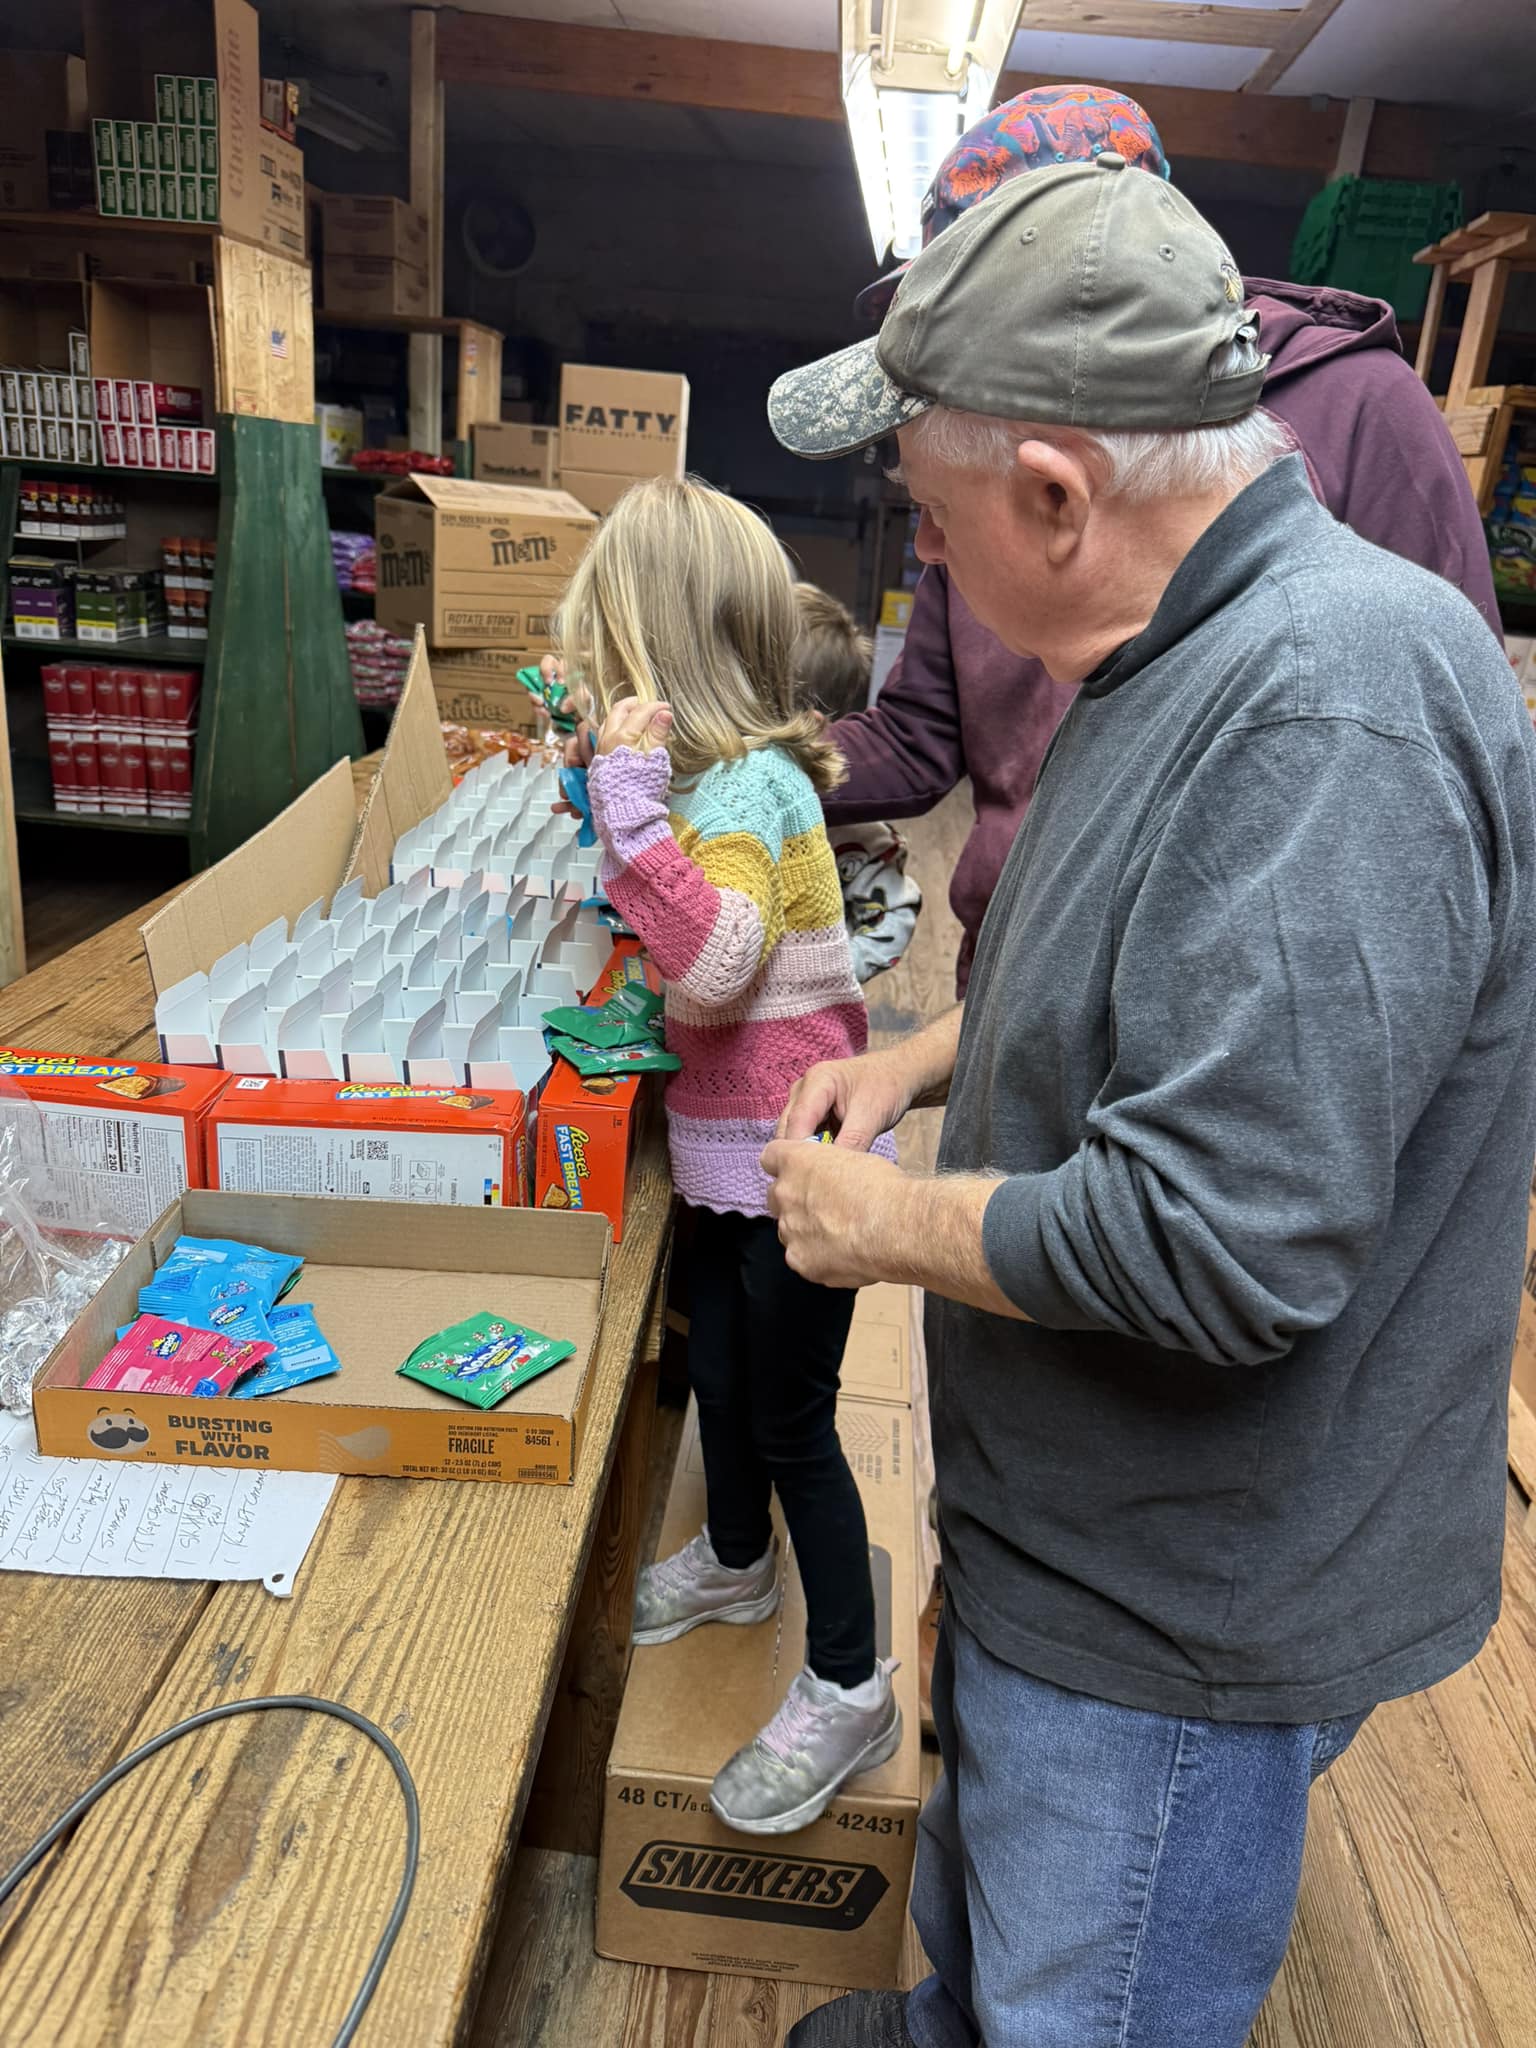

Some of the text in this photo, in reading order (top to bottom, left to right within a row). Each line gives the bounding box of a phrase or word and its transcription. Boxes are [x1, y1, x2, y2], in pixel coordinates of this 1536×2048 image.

[566, 404, 676, 434] FATTY
[35, 1065, 130, 1076] BREAK
[132, 1123, 141, 1175] Nutrition Facts
[569, 1126, 591, 1179] Reese's
[108, 1153, 117, 1172] 230
[556, 1127, 582, 1207] FAST BREAK
[168, 1415, 273, 1433] BURSTING
[201, 1431, 242, 1443] WITH
[448, 1438, 495, 1454] FRAGILE
[525, 1435, 551, 1447] 84561
[175, 1440, 271, 1460] FLAVOR
[617, 1786, 646, 1805] 48
[638, 1847, 857, 1905] SNICKERS
